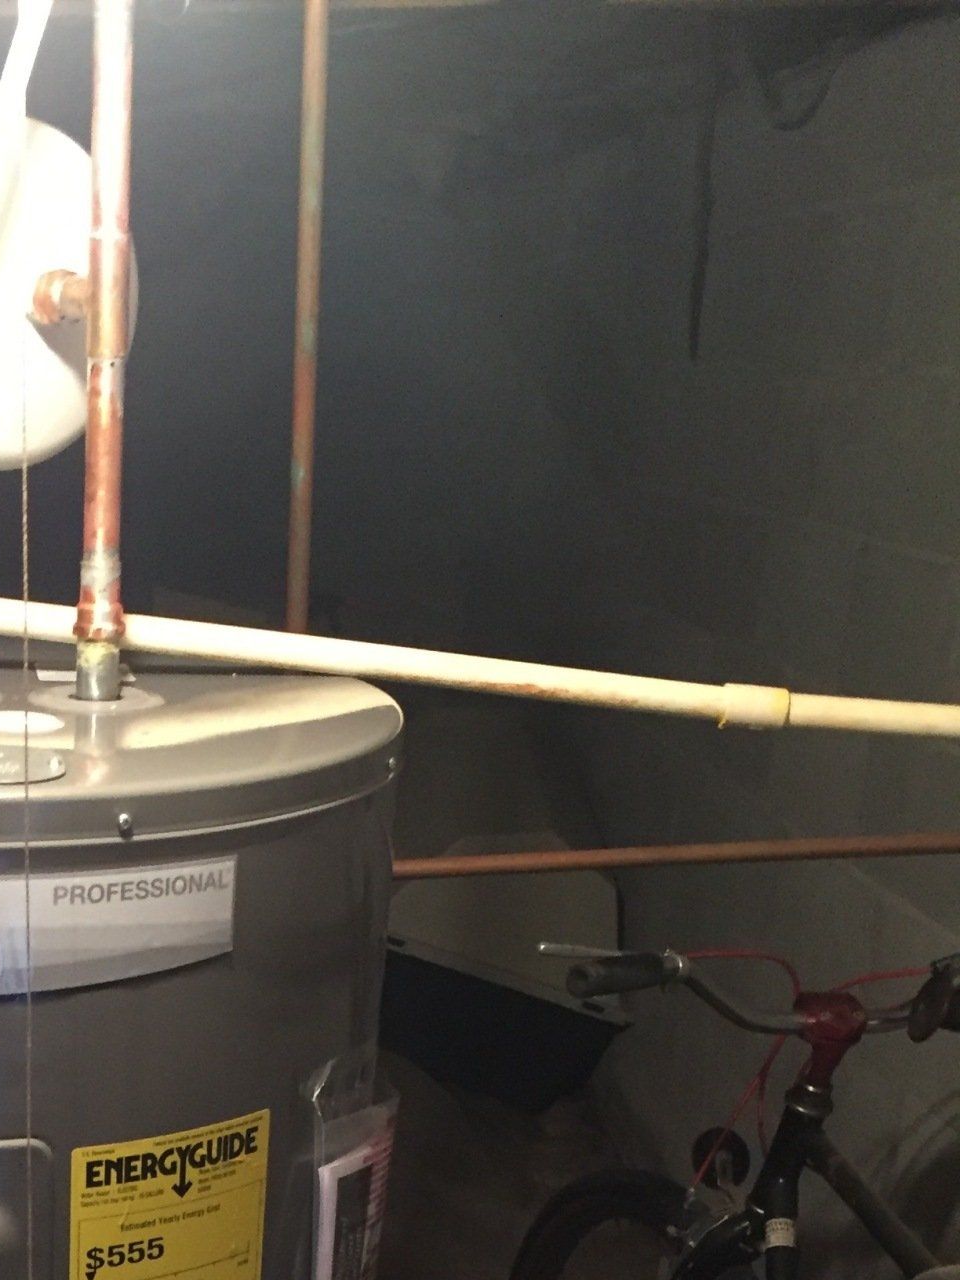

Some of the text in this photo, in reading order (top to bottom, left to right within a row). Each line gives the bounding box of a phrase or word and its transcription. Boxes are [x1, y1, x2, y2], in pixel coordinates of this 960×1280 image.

[52, 869, 230, 906] PROFESSIONAL
[85, 1126, 259, 1189] ENERGYGUIDE
[85, 1236, 165, 1271] $555
